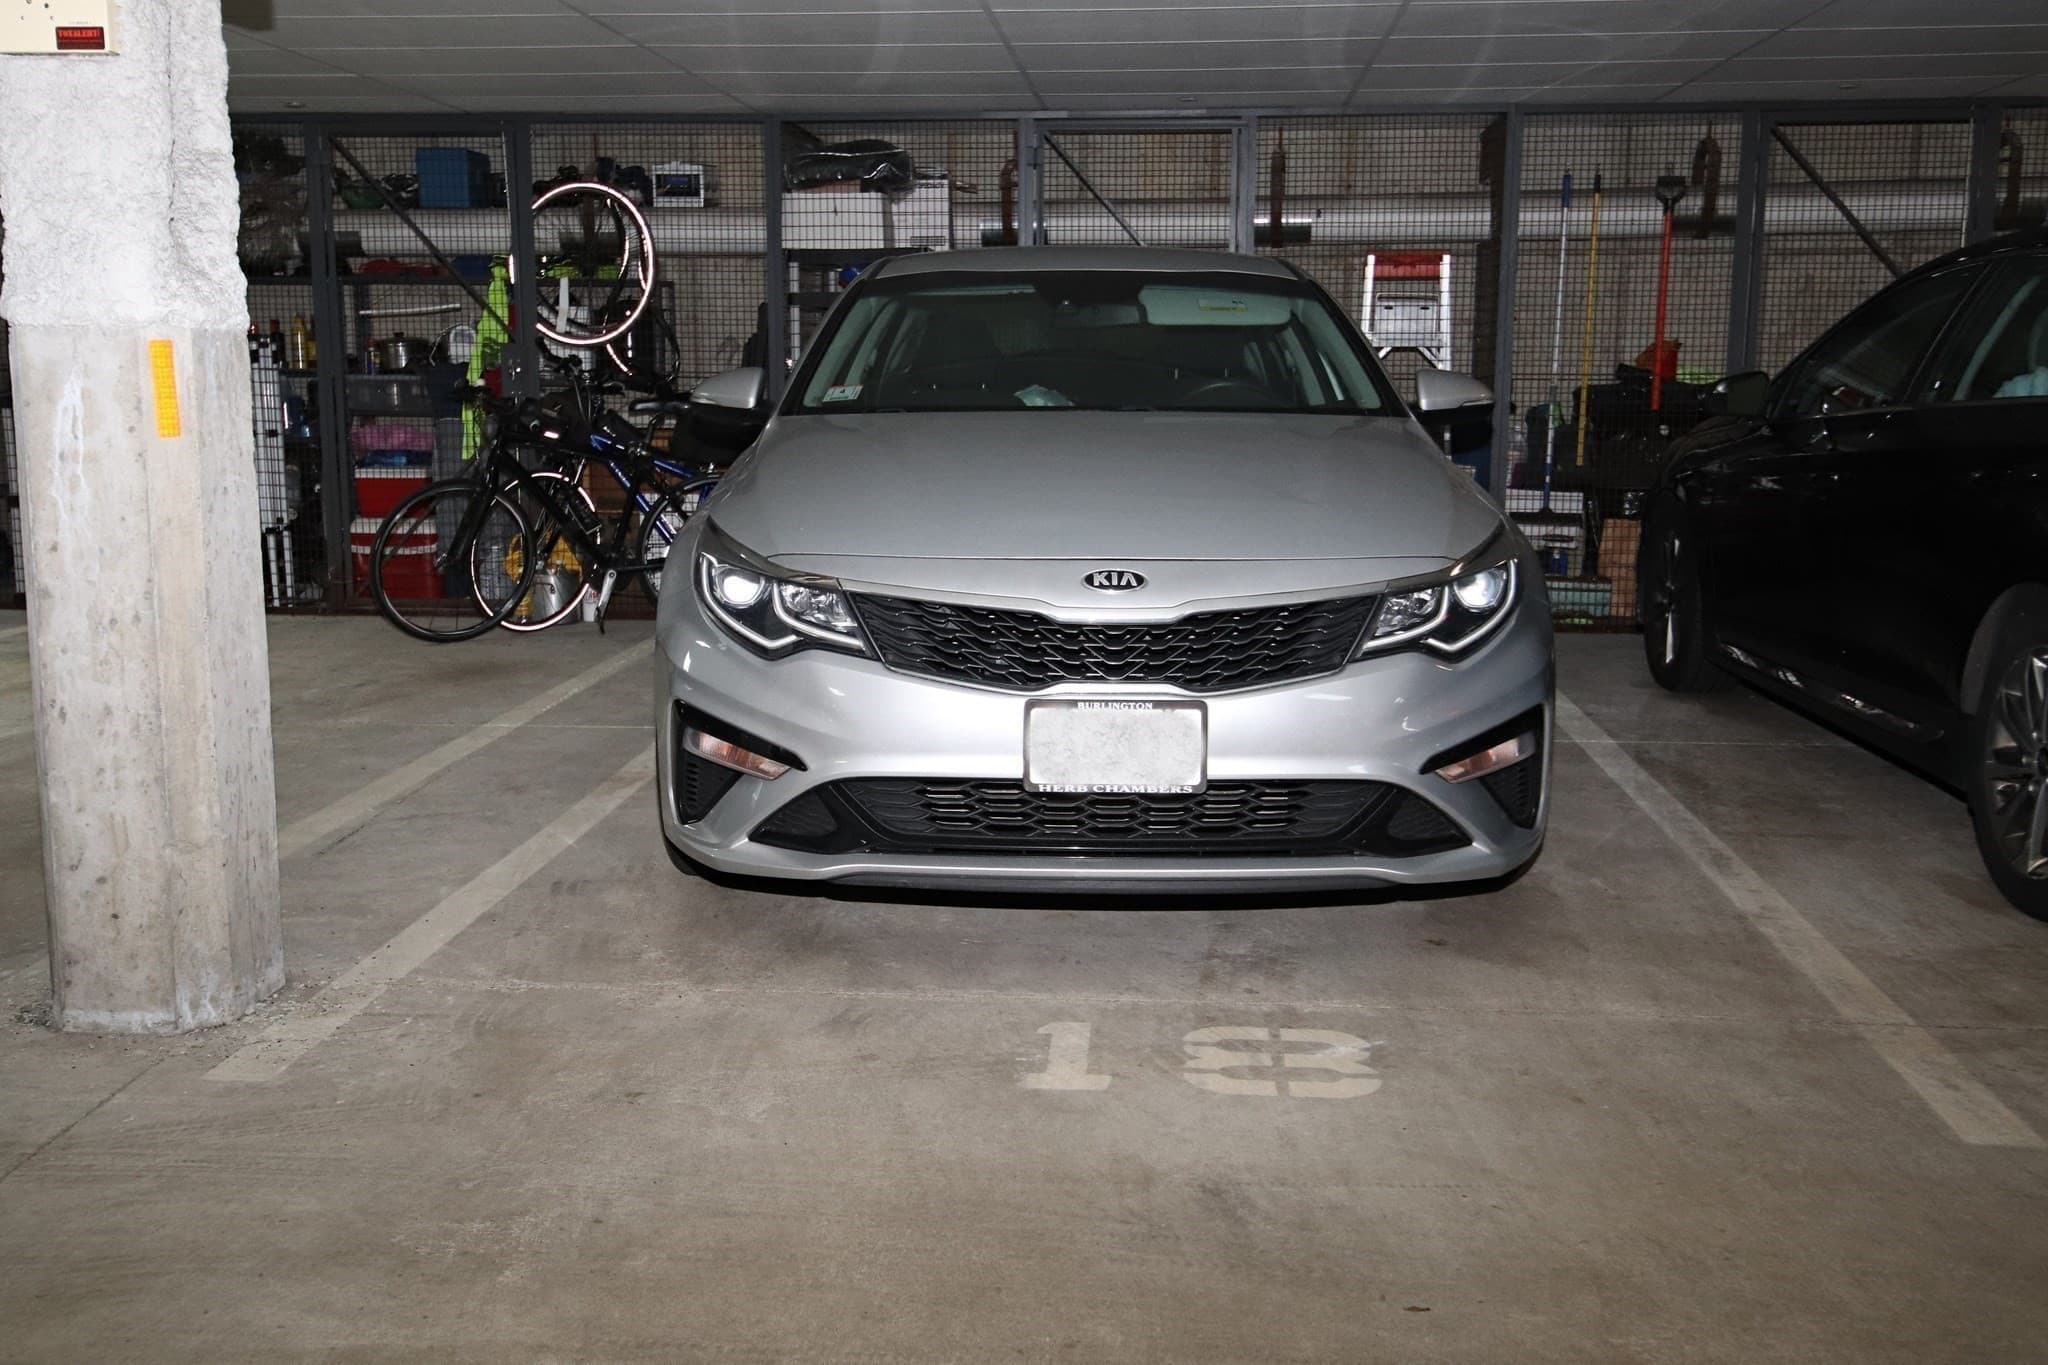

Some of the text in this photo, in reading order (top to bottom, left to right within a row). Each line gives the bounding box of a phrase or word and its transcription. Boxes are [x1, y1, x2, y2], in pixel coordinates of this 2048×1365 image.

[1092, 572, 1138, 586] KIA
[1077, 702, 1153, 711] BURLINGTON
[1038, 784, 1193, 794] HERB CHAMBERS
